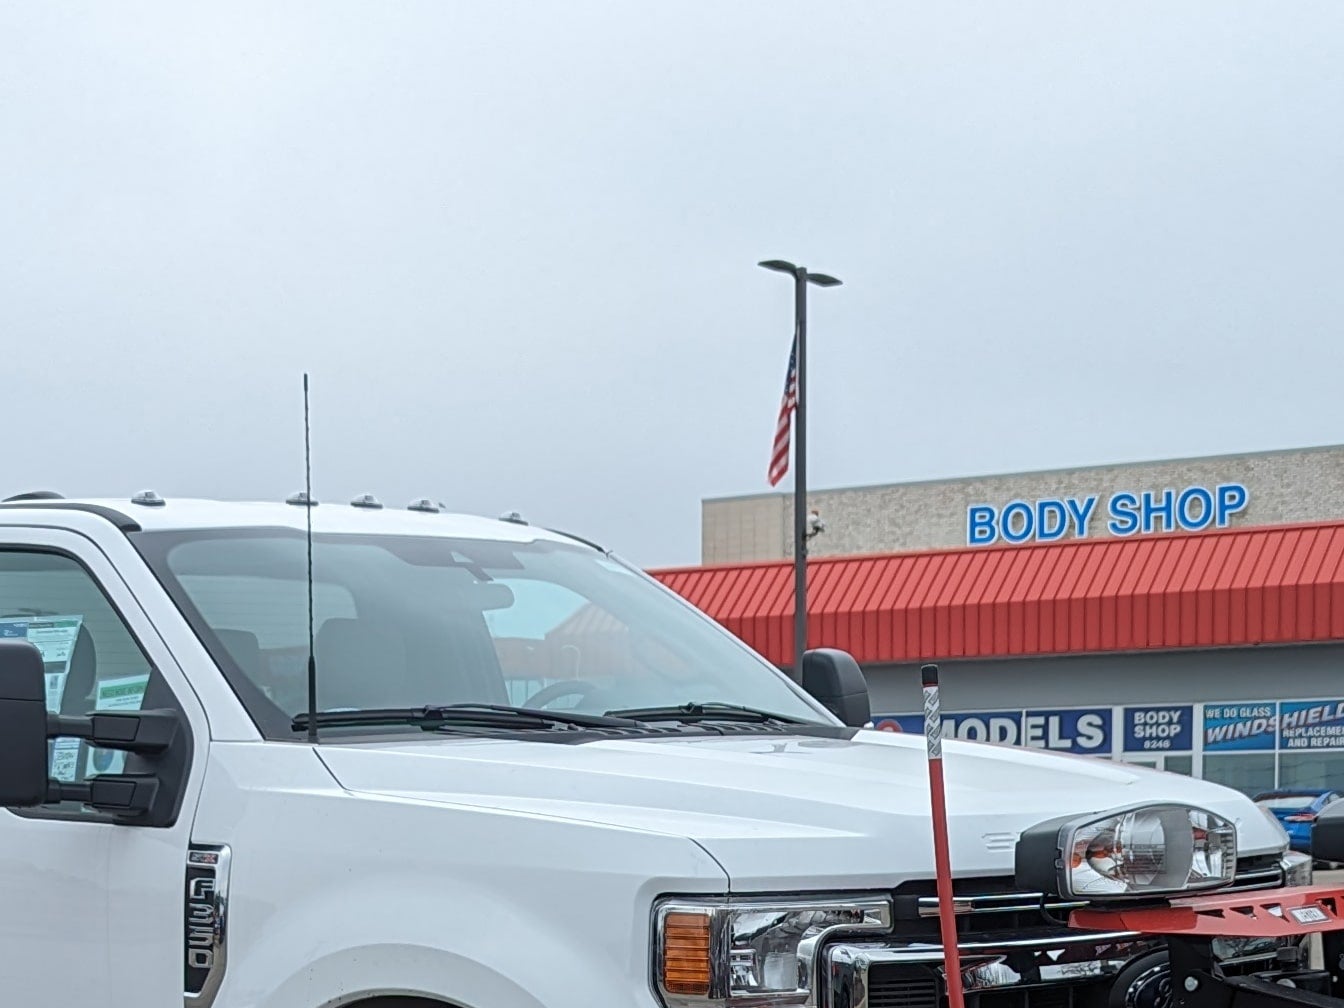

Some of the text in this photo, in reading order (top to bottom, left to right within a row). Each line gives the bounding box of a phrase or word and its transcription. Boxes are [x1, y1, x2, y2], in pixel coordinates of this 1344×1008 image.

[967, 484, 1249, 546] BODY SHOP
[1134, 710, 1182, 725] BODY
[1205, 706, 1272, 719] WE DO GLASS
[1134, 724, 1182, 738] SHOP
[1287, 737, 1308, 748] AND
